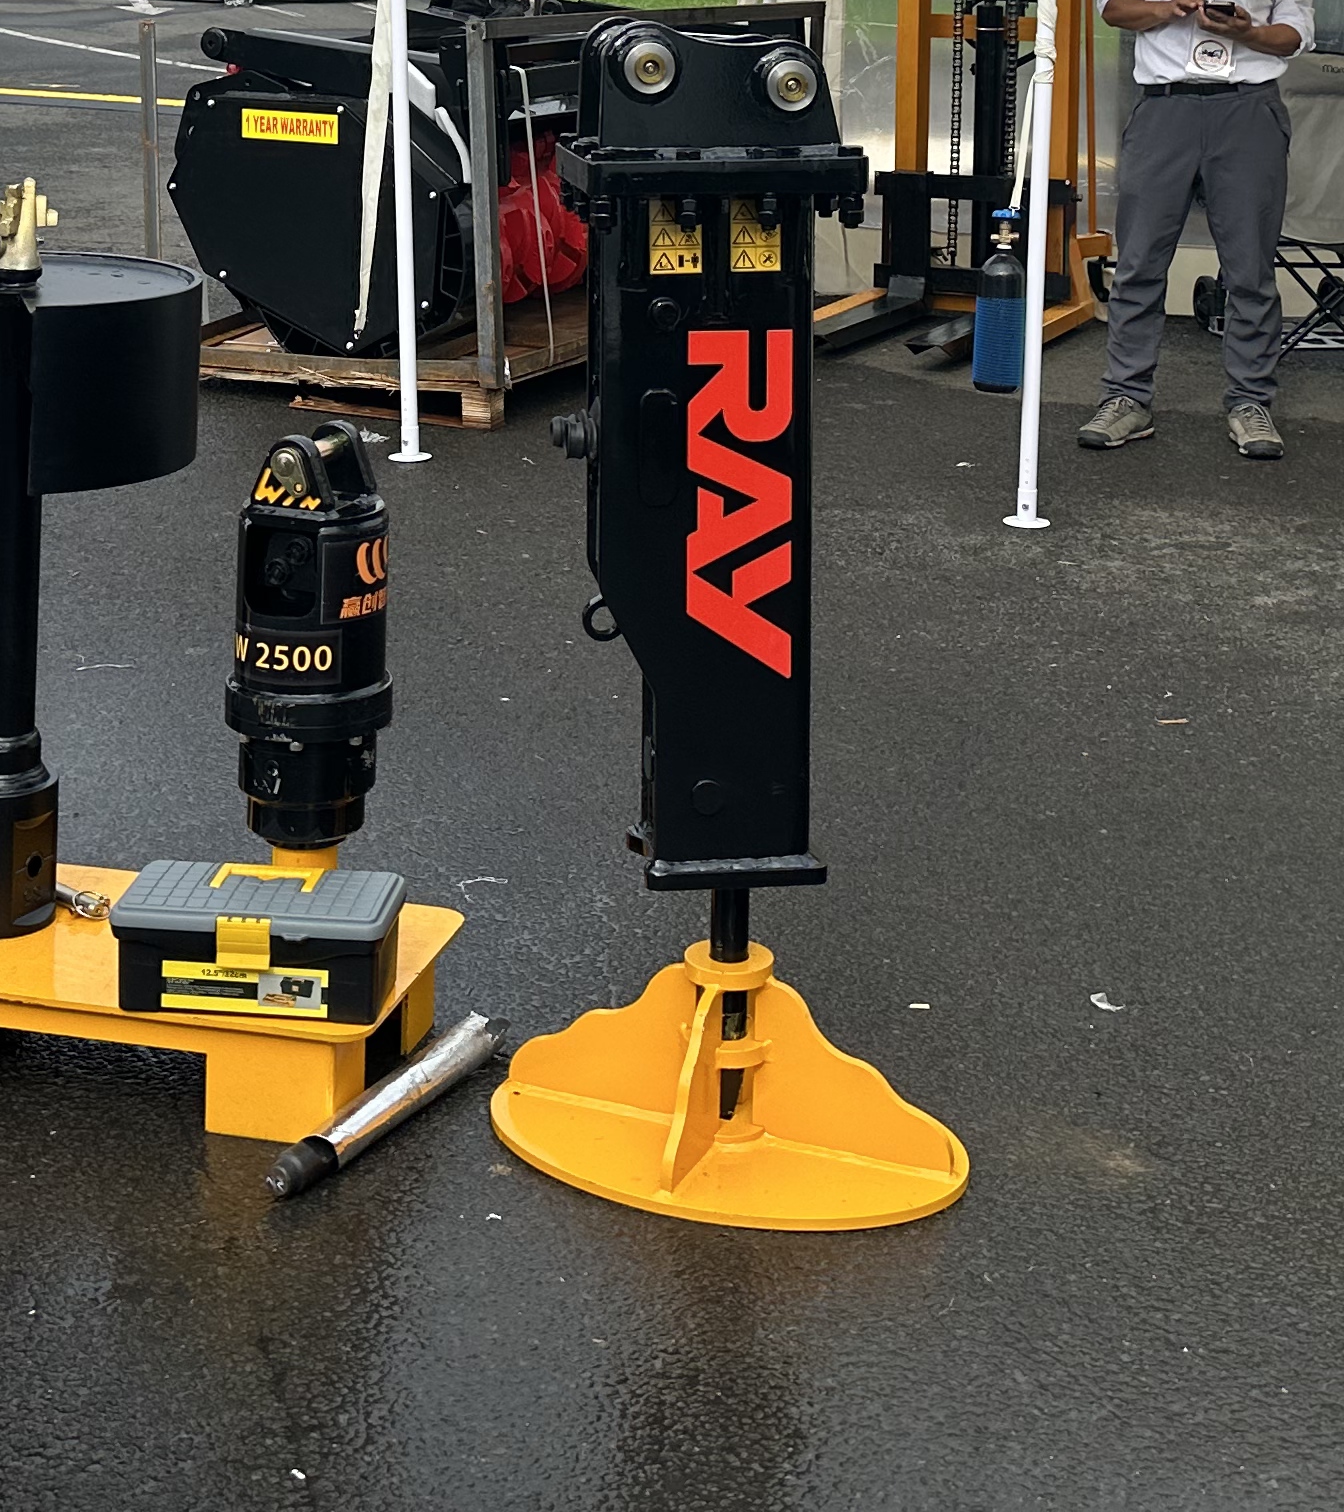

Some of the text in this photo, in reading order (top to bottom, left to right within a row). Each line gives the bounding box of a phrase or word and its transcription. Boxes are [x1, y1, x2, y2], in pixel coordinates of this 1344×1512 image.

[245, 114, 335, 138] 1 YEAR WARRANTY
[686, 329, 793, 679] RAY
[255, 641, 333, 672] 2500
